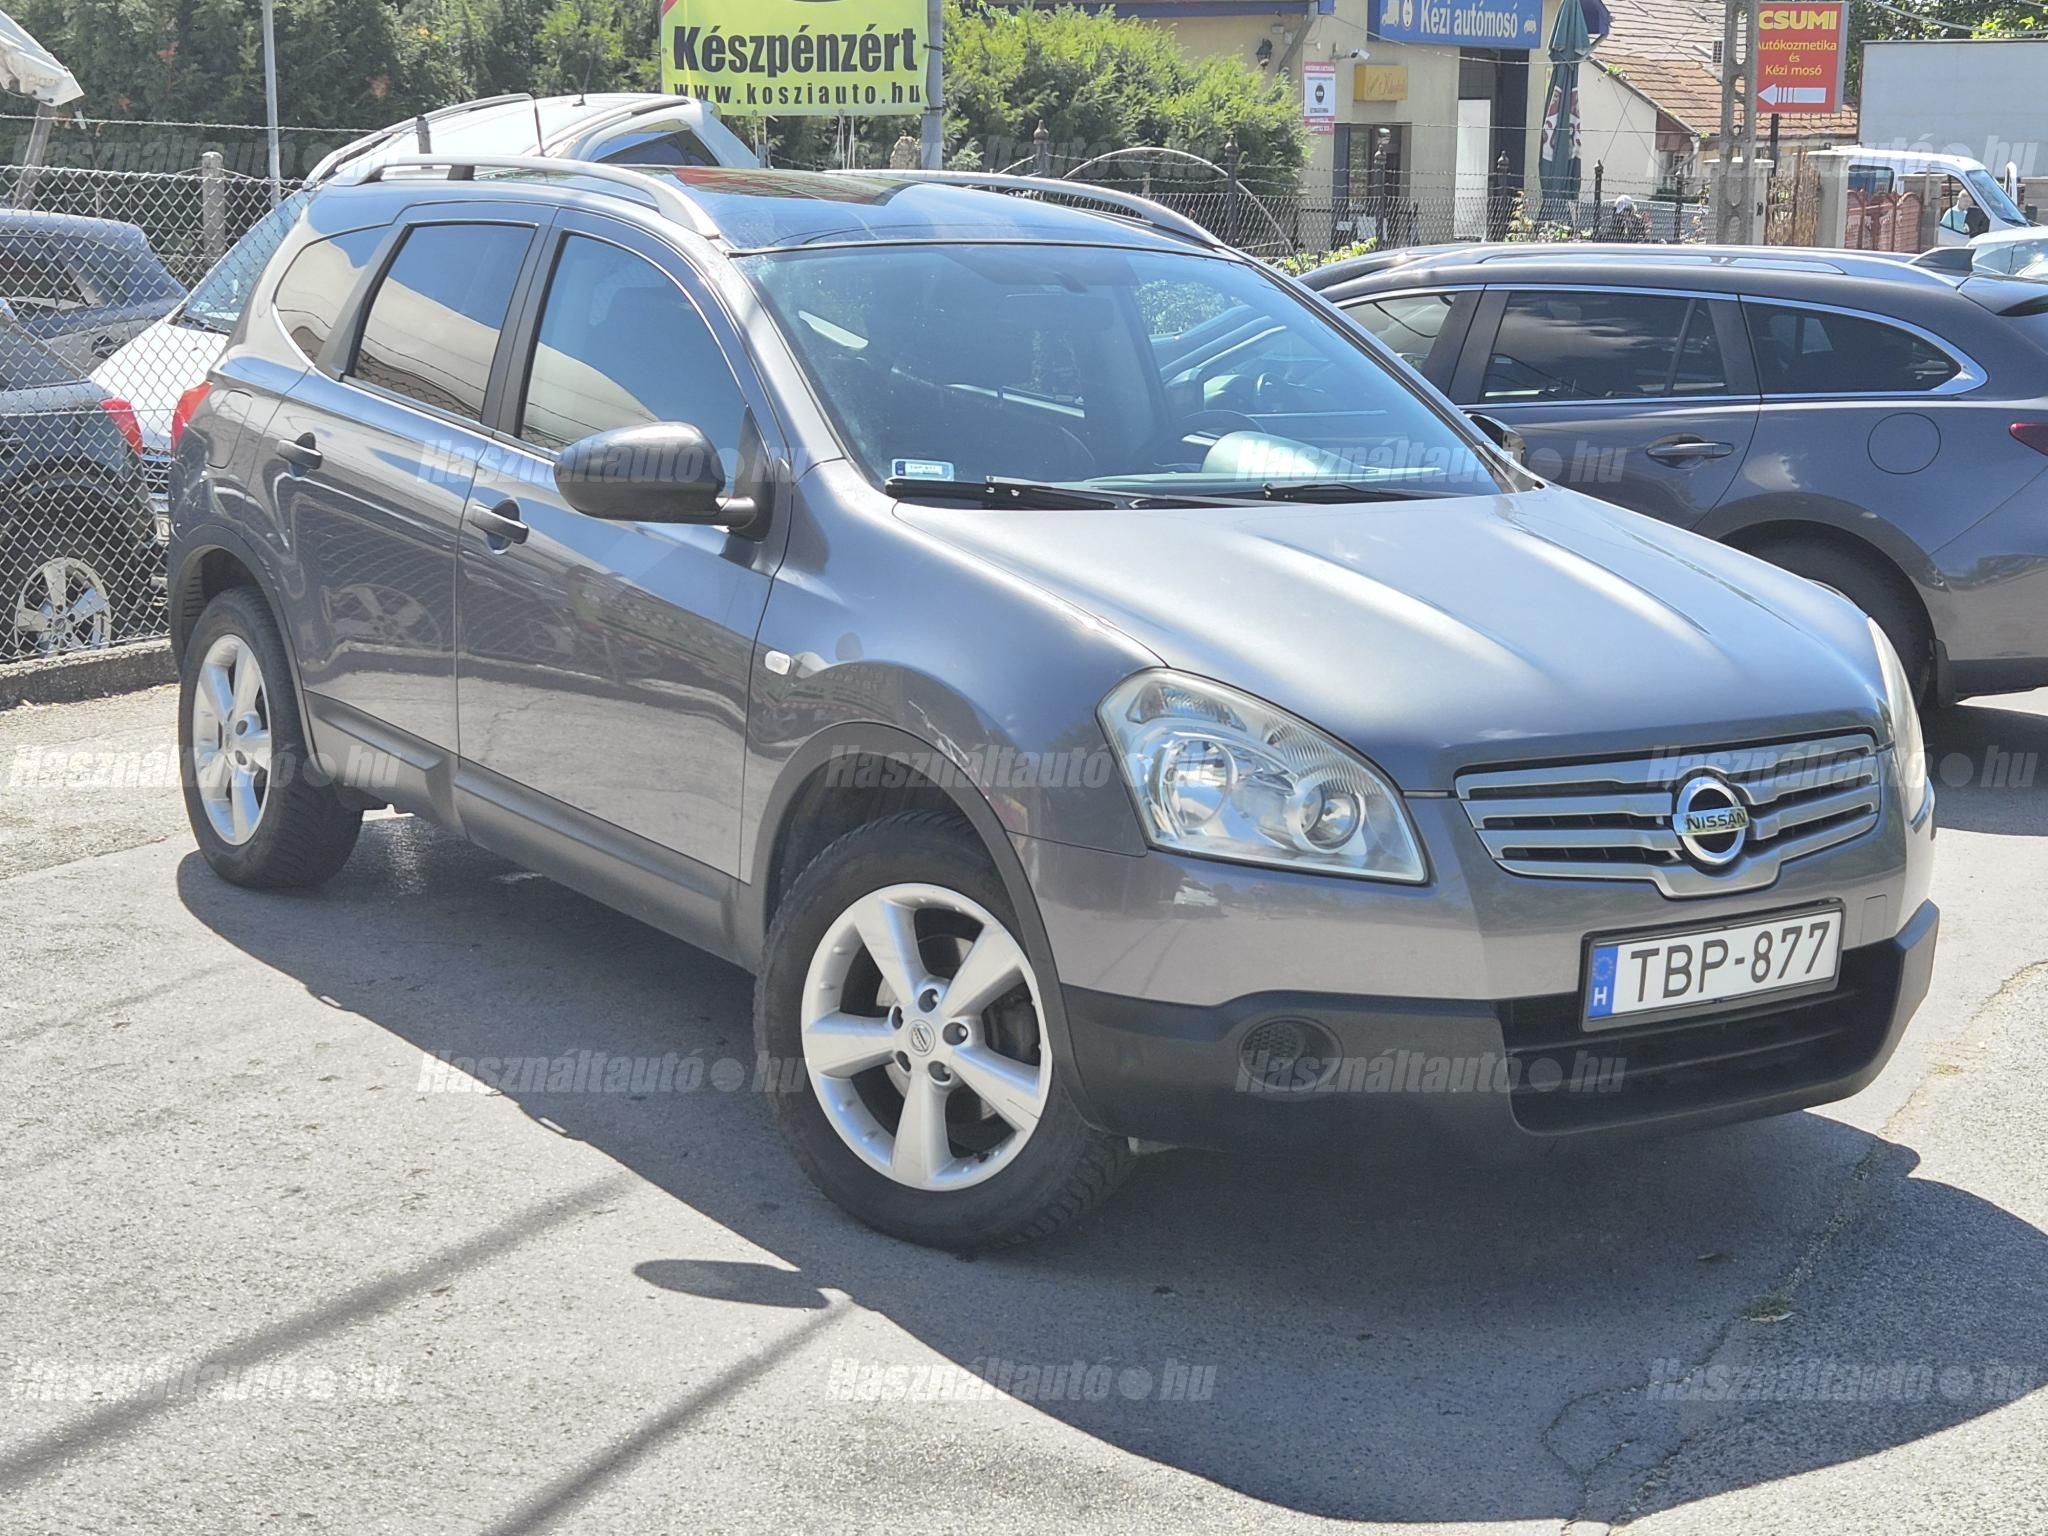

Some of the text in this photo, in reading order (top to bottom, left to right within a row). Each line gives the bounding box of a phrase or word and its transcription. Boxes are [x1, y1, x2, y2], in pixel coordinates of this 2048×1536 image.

[1454, 2, 1518, 39] autómosó
[1759, 10, 1838, 30] CSUMI
[673, 23, 918, 78] Készpénzért
[1788, 52, 1801, 63] és
[1765, 64, 1823, 76] Kézi mosó
[674, 81, 922, 105] www.kosziauto.hu
[1686, 810, 1746, 830] NISSAN
[1630, 920, 1831, 1003] TBP-877
[1593, 986, 1608, 1007] H
